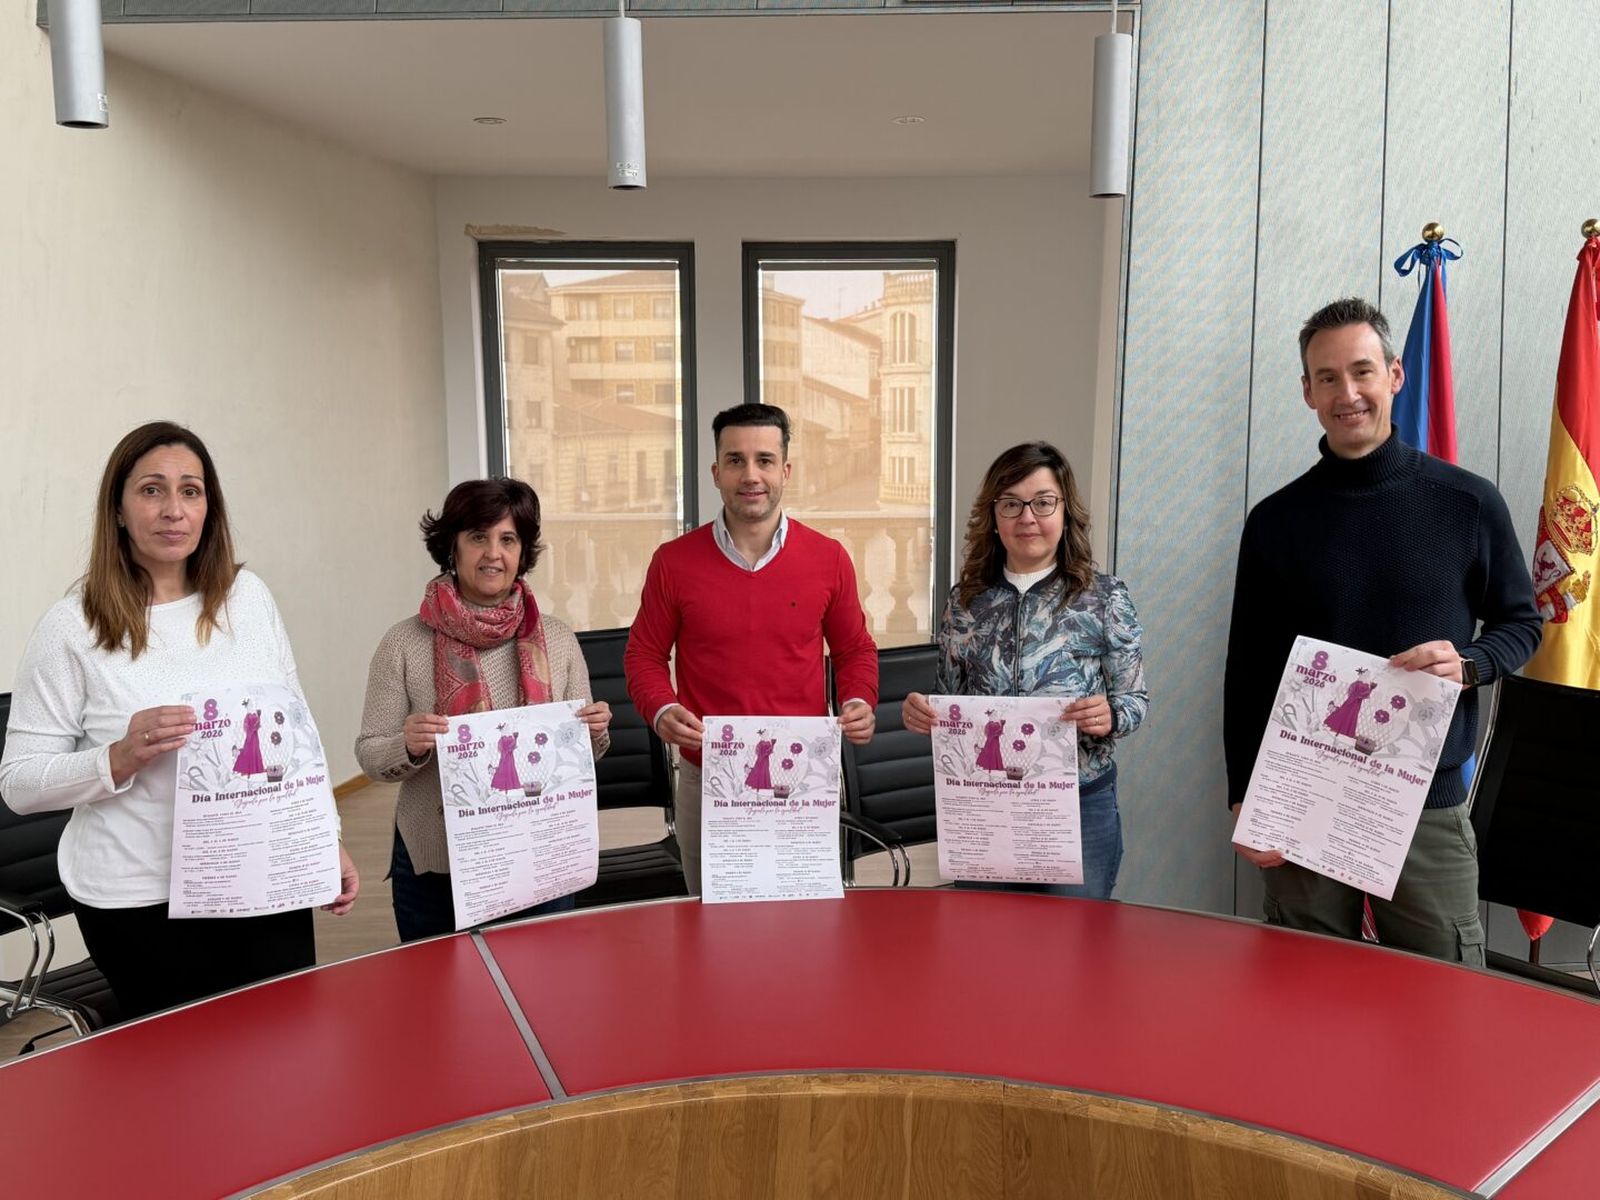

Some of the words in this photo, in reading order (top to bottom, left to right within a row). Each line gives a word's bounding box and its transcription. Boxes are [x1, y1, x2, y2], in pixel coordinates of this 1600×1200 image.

[1312, 651, 1328, 670] 8
[1296, 665, 1337, 683] marzo
[1303, 676, 1325, 688] 2026
[203, 698, 218, 720] 8
[949, 704, 961, 721] 8
[192, 719, 231, 731] marzo
[939, 720, 973, 729] marzo
[200, 730, 223, 739] 2026
[457, 724, 472, 743] 8
[722, 724, 734, 741] 8
[447, 740, 485, 754] marzo
[711, 741, 745, 750] marzo
[457, 750, 478, 759] 2026
[1300, 736, 1367, 764] Internacional
[1370, 759, 1382, 769] de
[1384, 764, 1395, 774] la
[1397, 769, 1427, 786] Mujer
[215, 783, 281, 801] Internacional
[284, 781, 294, 790] de
[296, 779, 304, 787] la
[963, 779, 1021, 789] Internacional
[1023, 781, 1035, 789] de
[1037, 781, 1046, 789] la
[1049, 782, 1075, 791] Mujer
[478, 798, 540, 815] Internacional
[543, 796, 554, 804] de
[568, 789, 593, 800] Mujer
[731, 799, 786, 807] Internacional
[789, 799, 799, 807] de
[812, 800, 837, 808] Mujer
